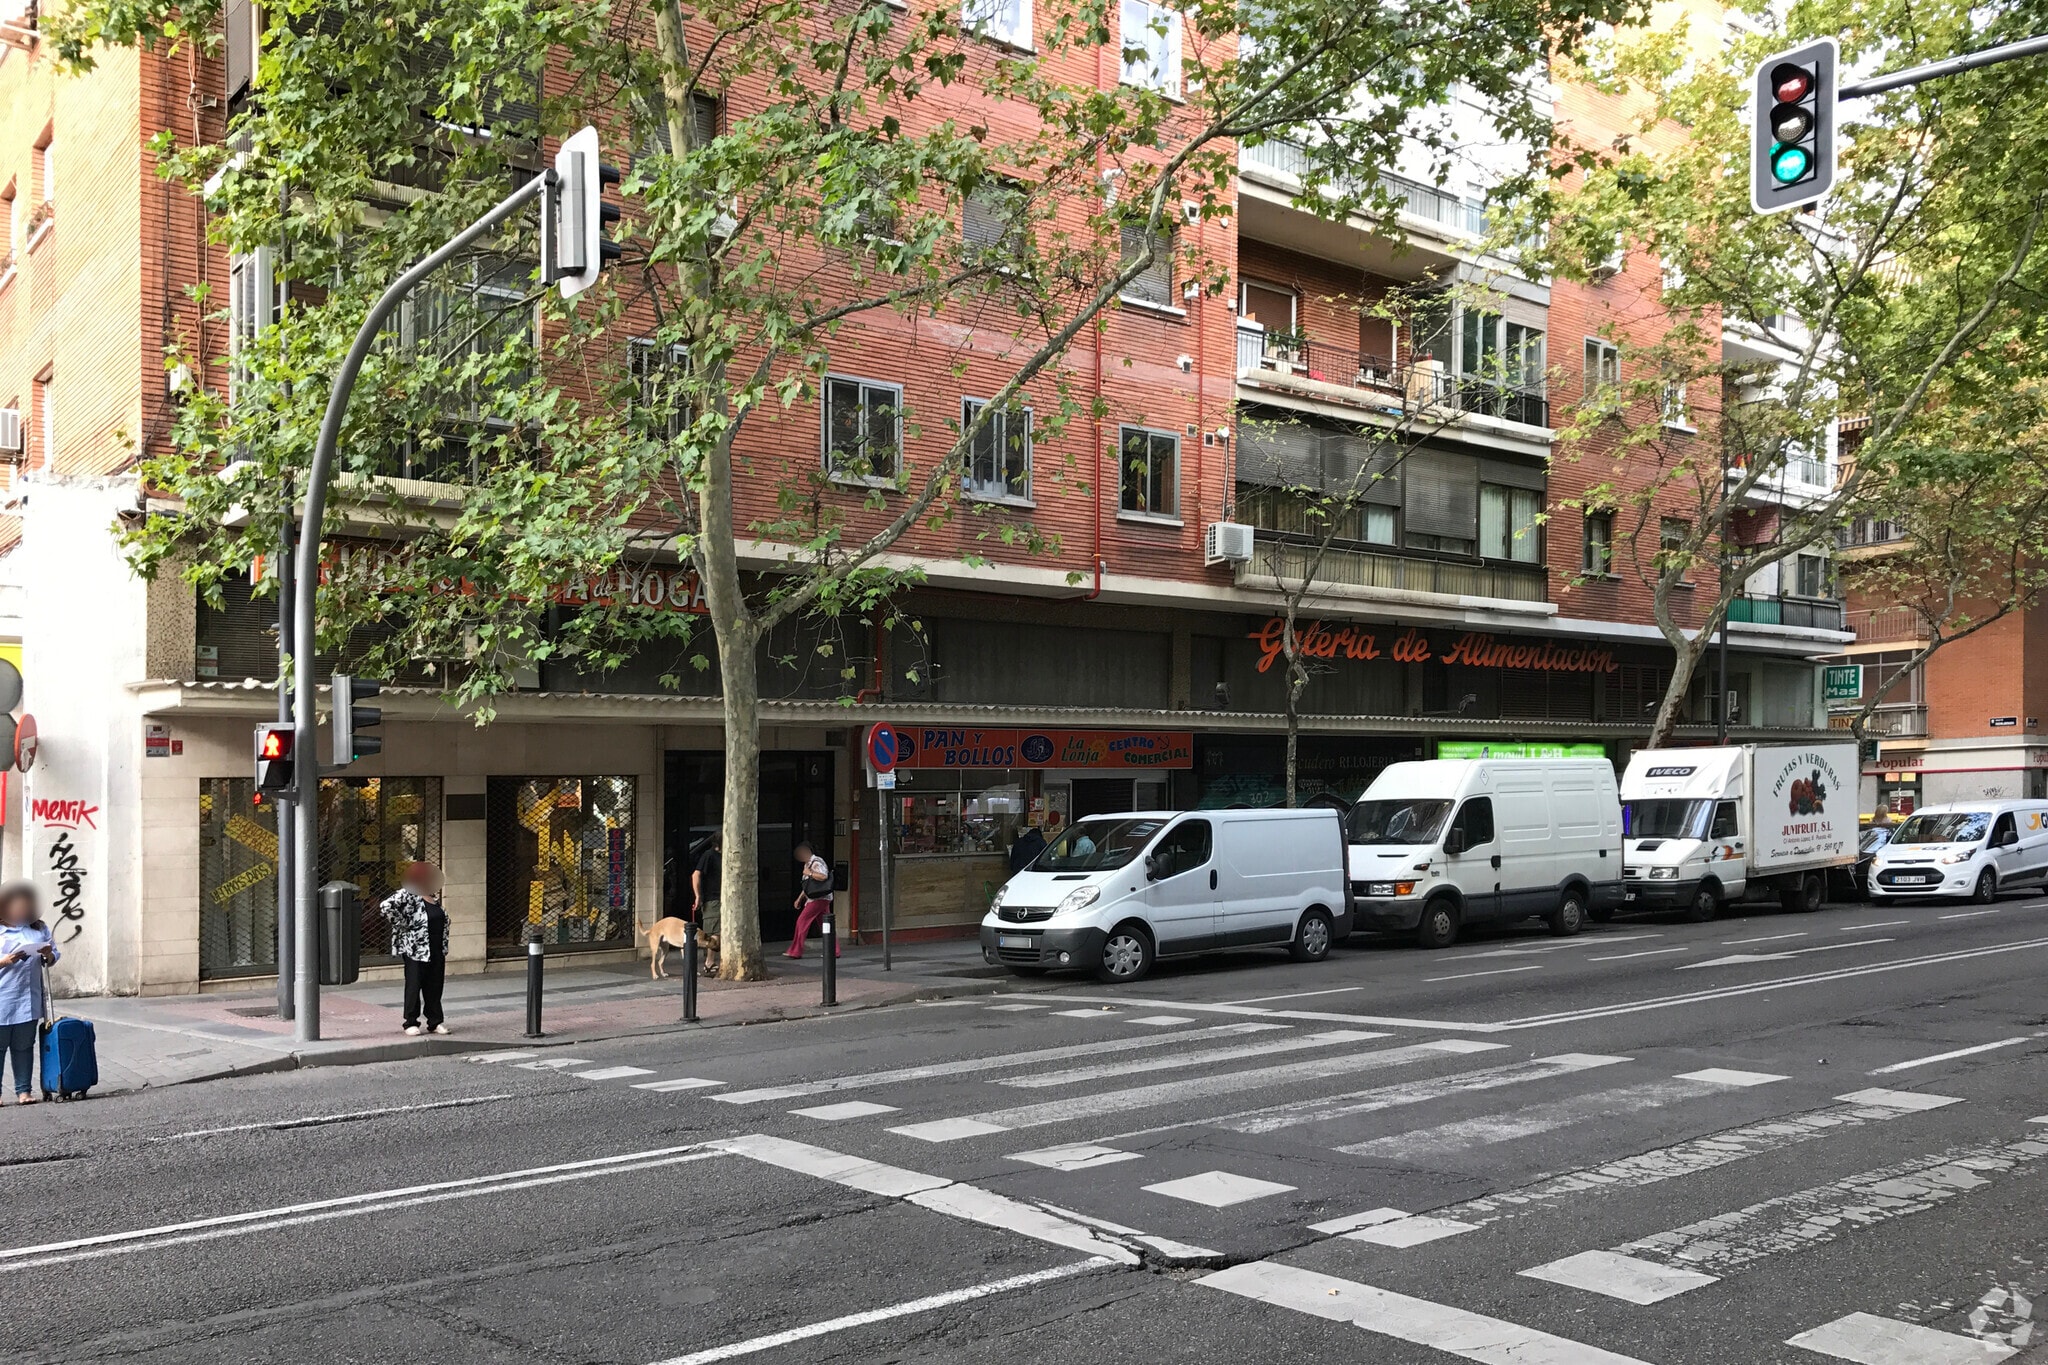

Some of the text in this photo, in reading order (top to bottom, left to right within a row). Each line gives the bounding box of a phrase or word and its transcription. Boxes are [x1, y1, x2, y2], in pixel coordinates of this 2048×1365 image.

[618, 570, 709, 608] HOGA
[1392, 628, 1432, 663] de
[1829, 669, 1856, 686] TINTE
[1826, 687, 1858, 697] Mas
[924, 730, 984, 750] PAN Y
[1068, 736, 1085, 750] La
[1108, 735, 1155, 752] CENTRO
[944, 746, 1015, 767] BOLLOS
[1060, 748, 1100, 766] Lonja
[1123, 747, 1189, 766] COMERCIAL
[1875, 756, 1924, 770] Popular
[811, 763, 819, 776] 6
[1650, 767, 1691, 776] IVECO
[1772, 758, 1798, 798] FRUTAS
[1805, 753, 1841, 791] VERDURAS
